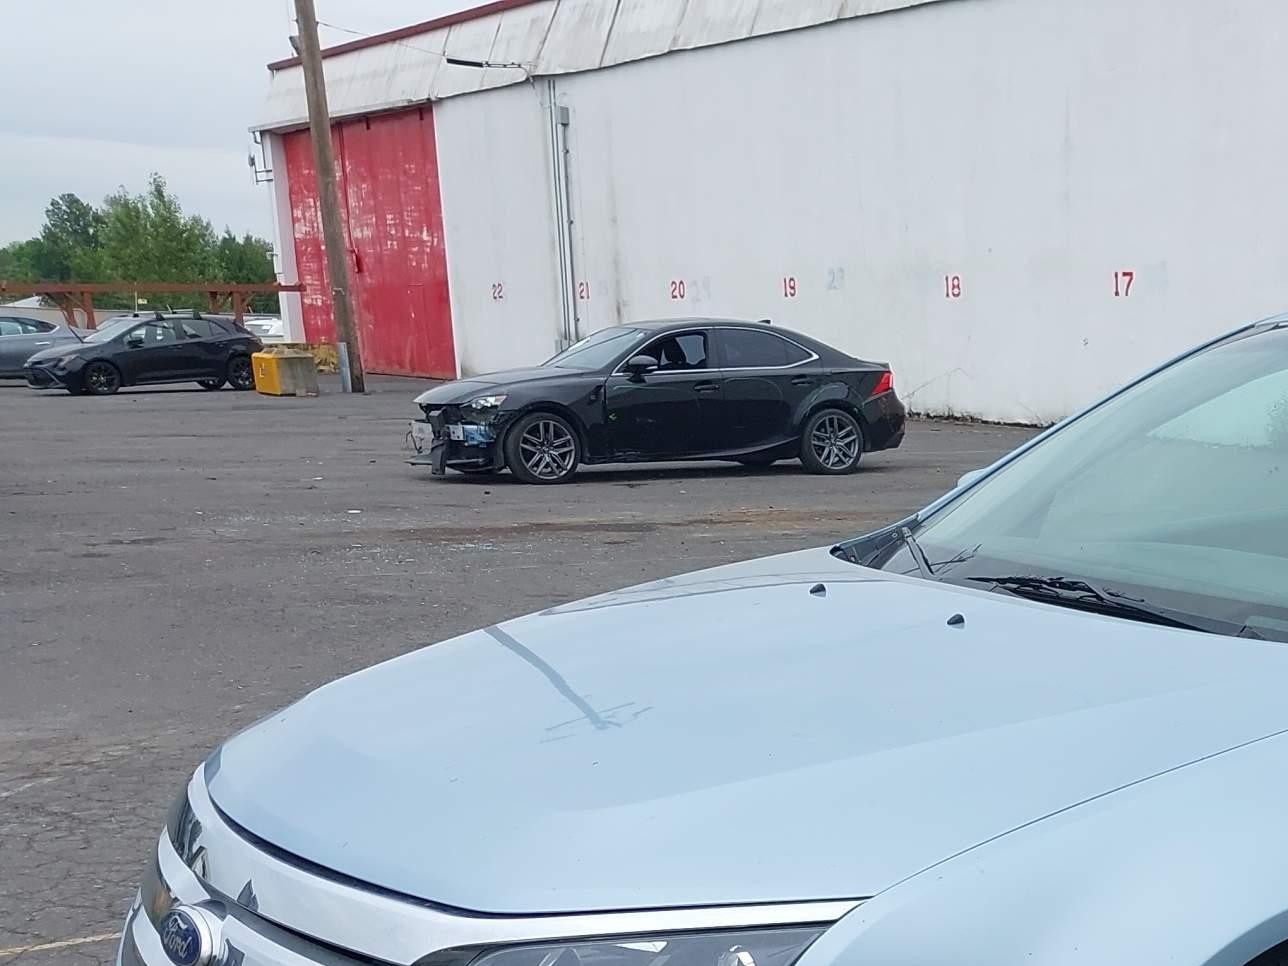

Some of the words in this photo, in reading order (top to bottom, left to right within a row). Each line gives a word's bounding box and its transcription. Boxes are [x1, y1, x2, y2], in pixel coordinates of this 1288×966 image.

[492, 283, 503, 299] 22
[579, 282, 590, 299] 21
[671, 280, 686, 299] 20
[783, 277, 797, 298] 19
[945, 275, 961, 298] 18
[1113, 271, 1134, 297] 17
[163, 915, 193, 959] Ford
